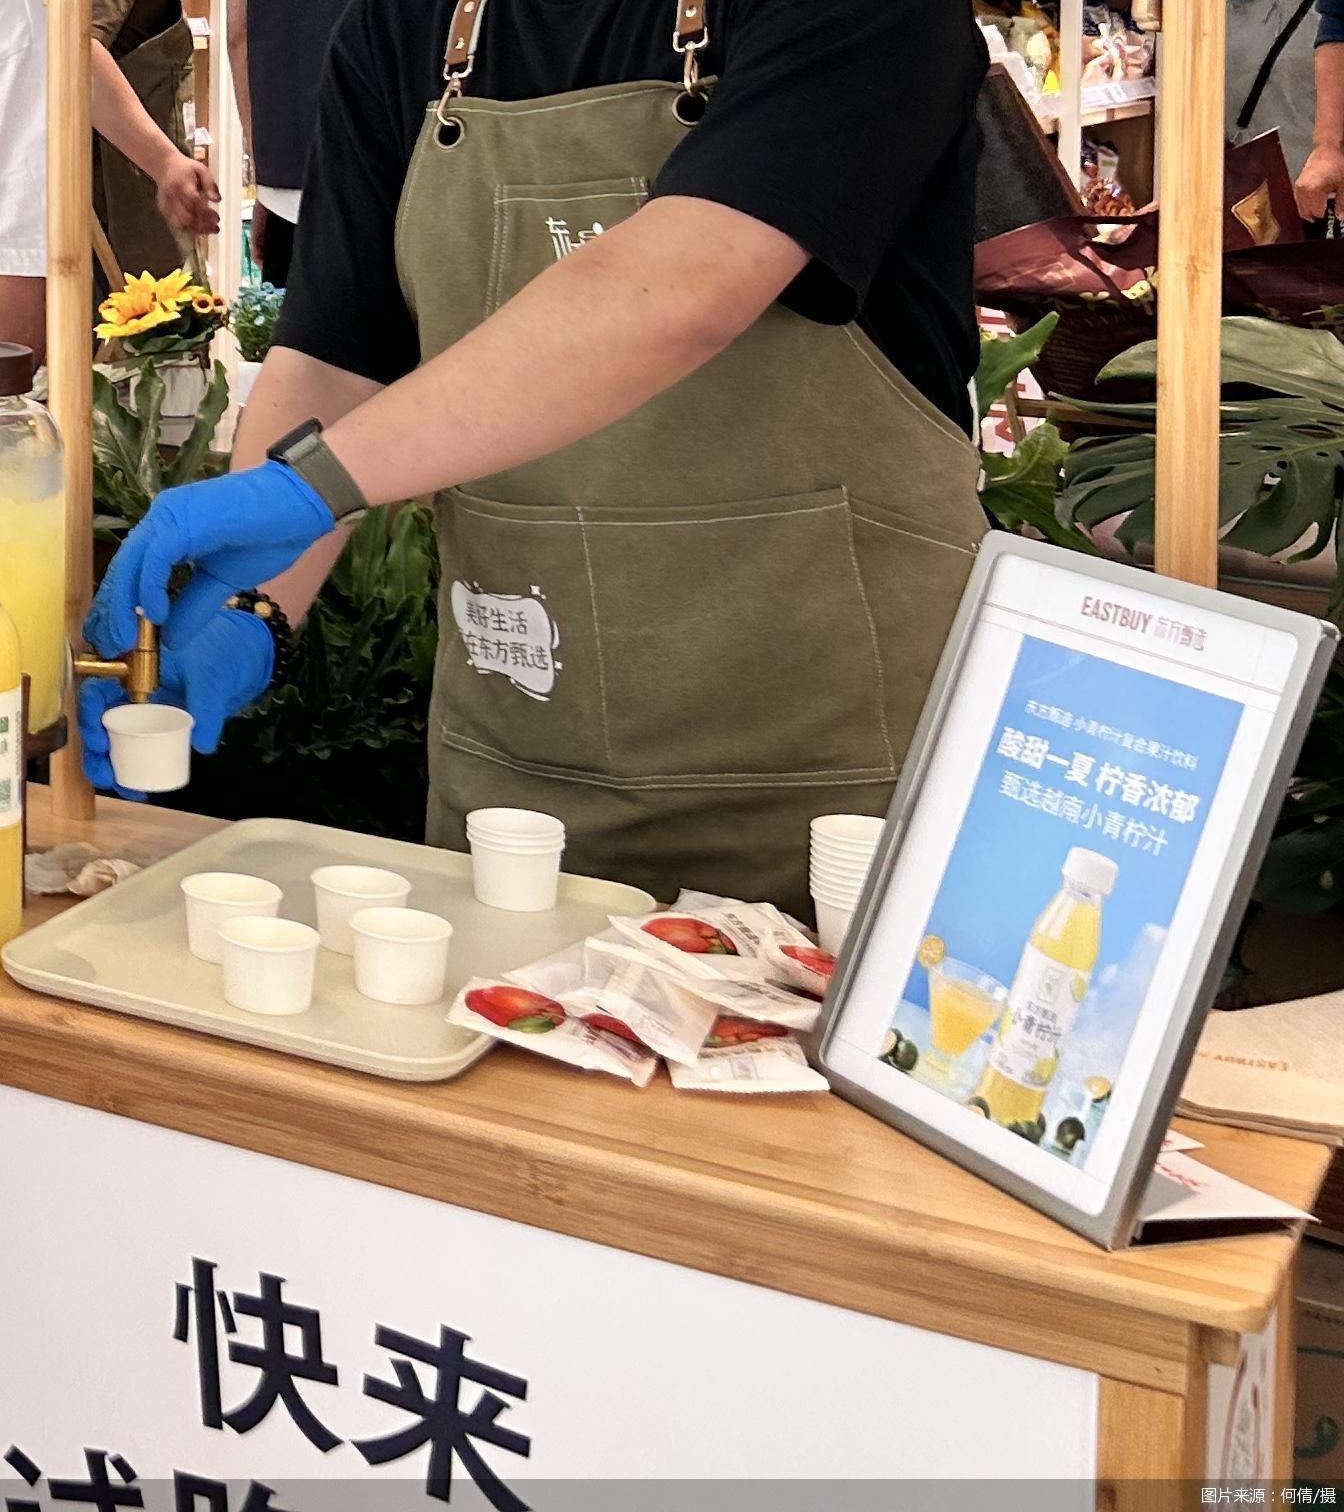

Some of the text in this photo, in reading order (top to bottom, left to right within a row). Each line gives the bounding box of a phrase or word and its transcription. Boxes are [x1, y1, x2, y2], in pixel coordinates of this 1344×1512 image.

[466, 601, 528, 635] 美好生活
[1080, 596, 1152, 634] EASTBUY
[996, 726, 1201, 824] 酸甜一夏 柠香浓郁
[999, 769, 1169, 856] 甄选越南小青柠汁
[173, 1256, 533, 1512] 快来
